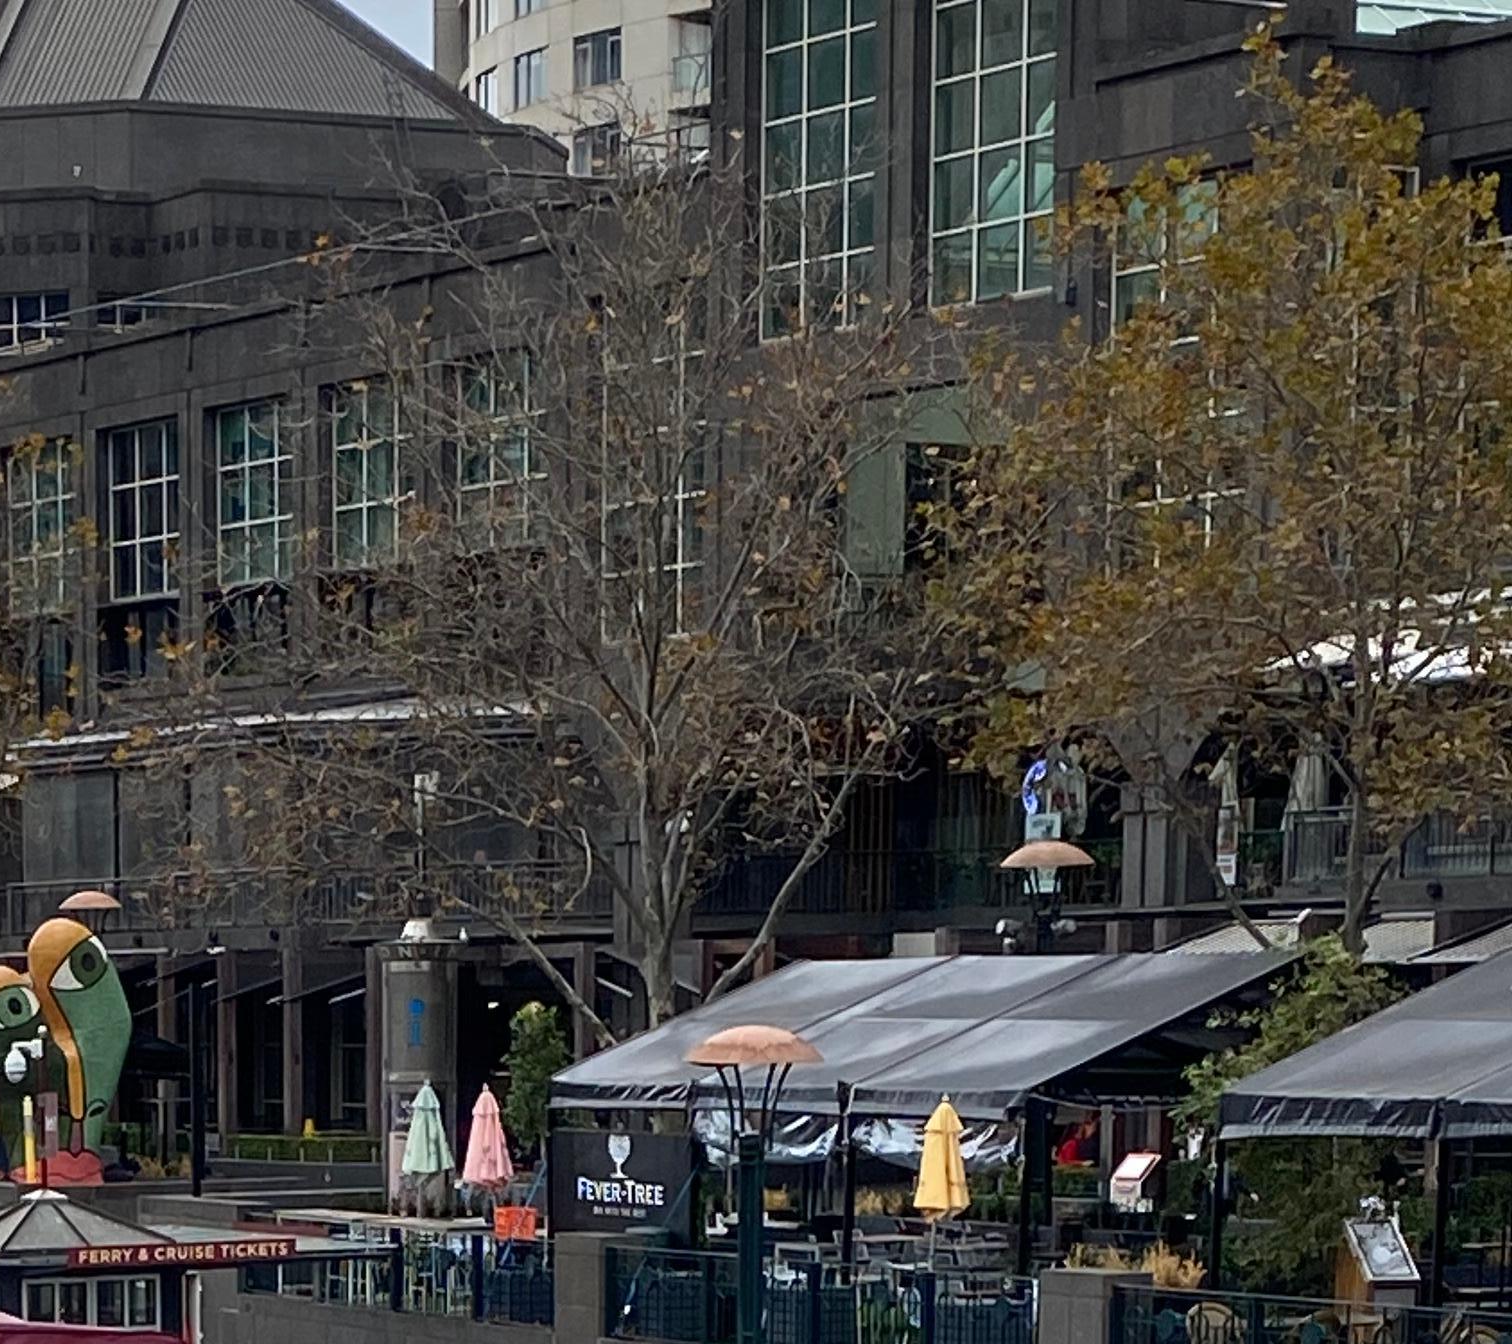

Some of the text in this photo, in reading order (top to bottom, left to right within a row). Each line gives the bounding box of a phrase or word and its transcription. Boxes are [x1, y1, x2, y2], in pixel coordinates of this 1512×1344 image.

[79, 1241, 288, 1265] FERRY & CRUISE TICKETS
